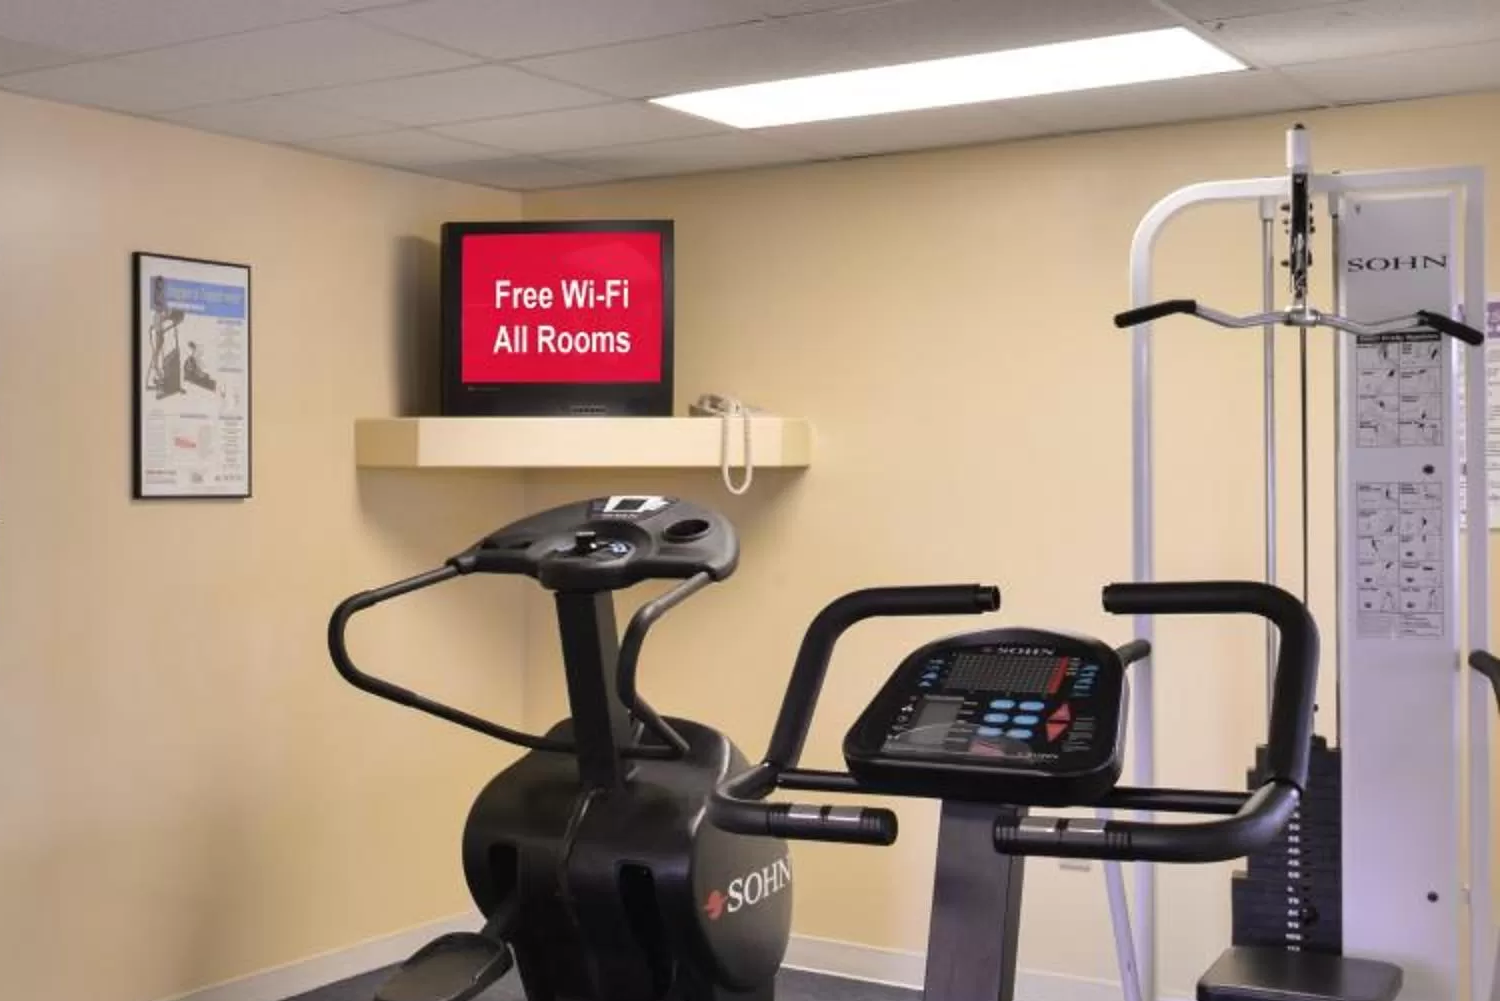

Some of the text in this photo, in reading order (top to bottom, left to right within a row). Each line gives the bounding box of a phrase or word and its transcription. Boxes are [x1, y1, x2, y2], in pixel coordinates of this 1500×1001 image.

[1347, 255, 1447, 272] SOHN
[495, 279, 629, 309] Free Wi-Fi
[493, 325, 631, 353] All Rooms
[727, 858, 790, 913] SOHN
